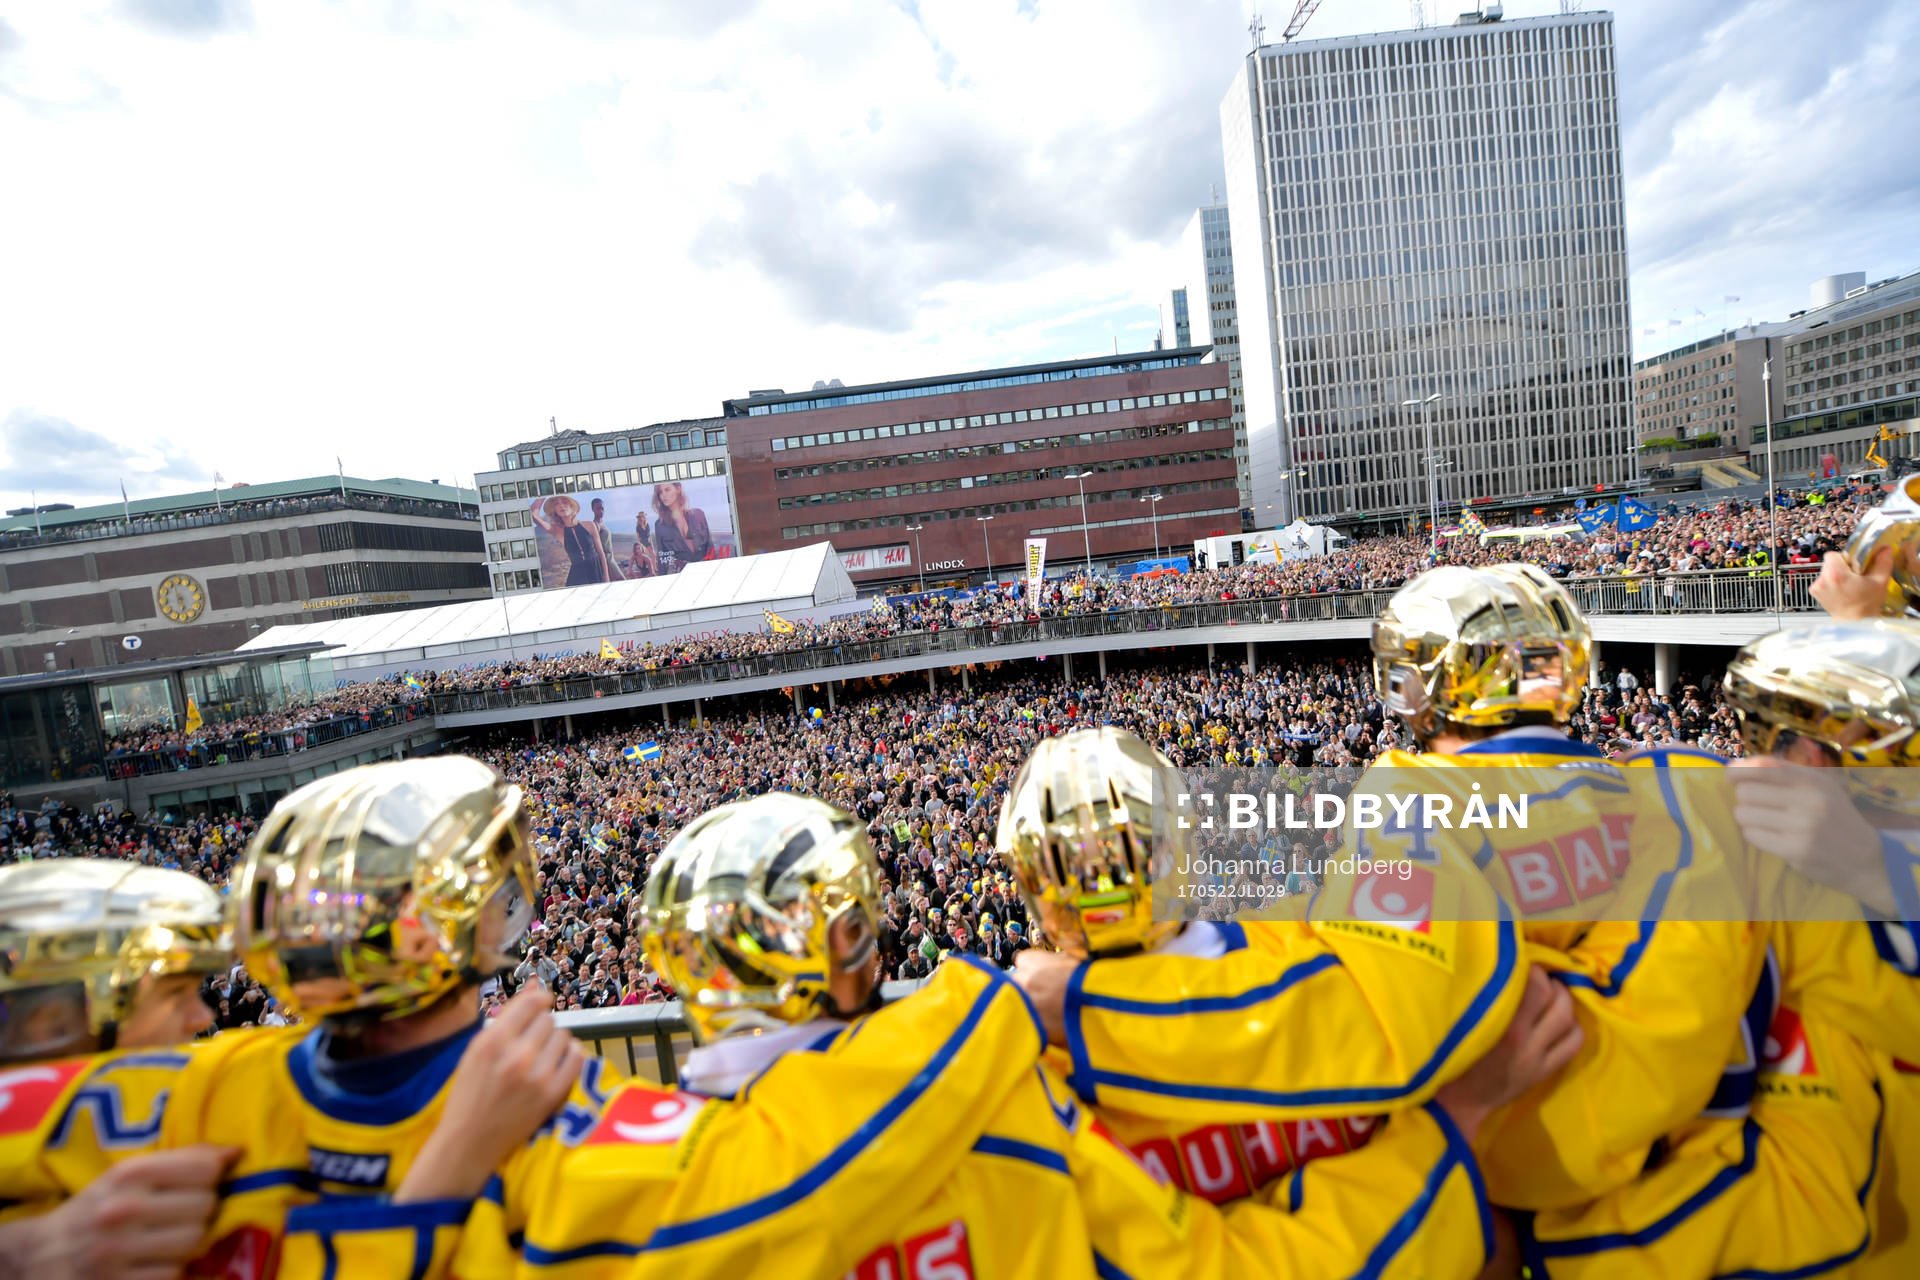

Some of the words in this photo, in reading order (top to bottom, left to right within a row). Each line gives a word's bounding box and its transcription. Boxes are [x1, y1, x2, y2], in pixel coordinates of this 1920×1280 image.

[1307, 514, 1337, 524] MANGO
[845, 552, 865, 569] H&M
[884, 547, 906, 564] H&M
[926, 559, 965, 571] LINDEX
